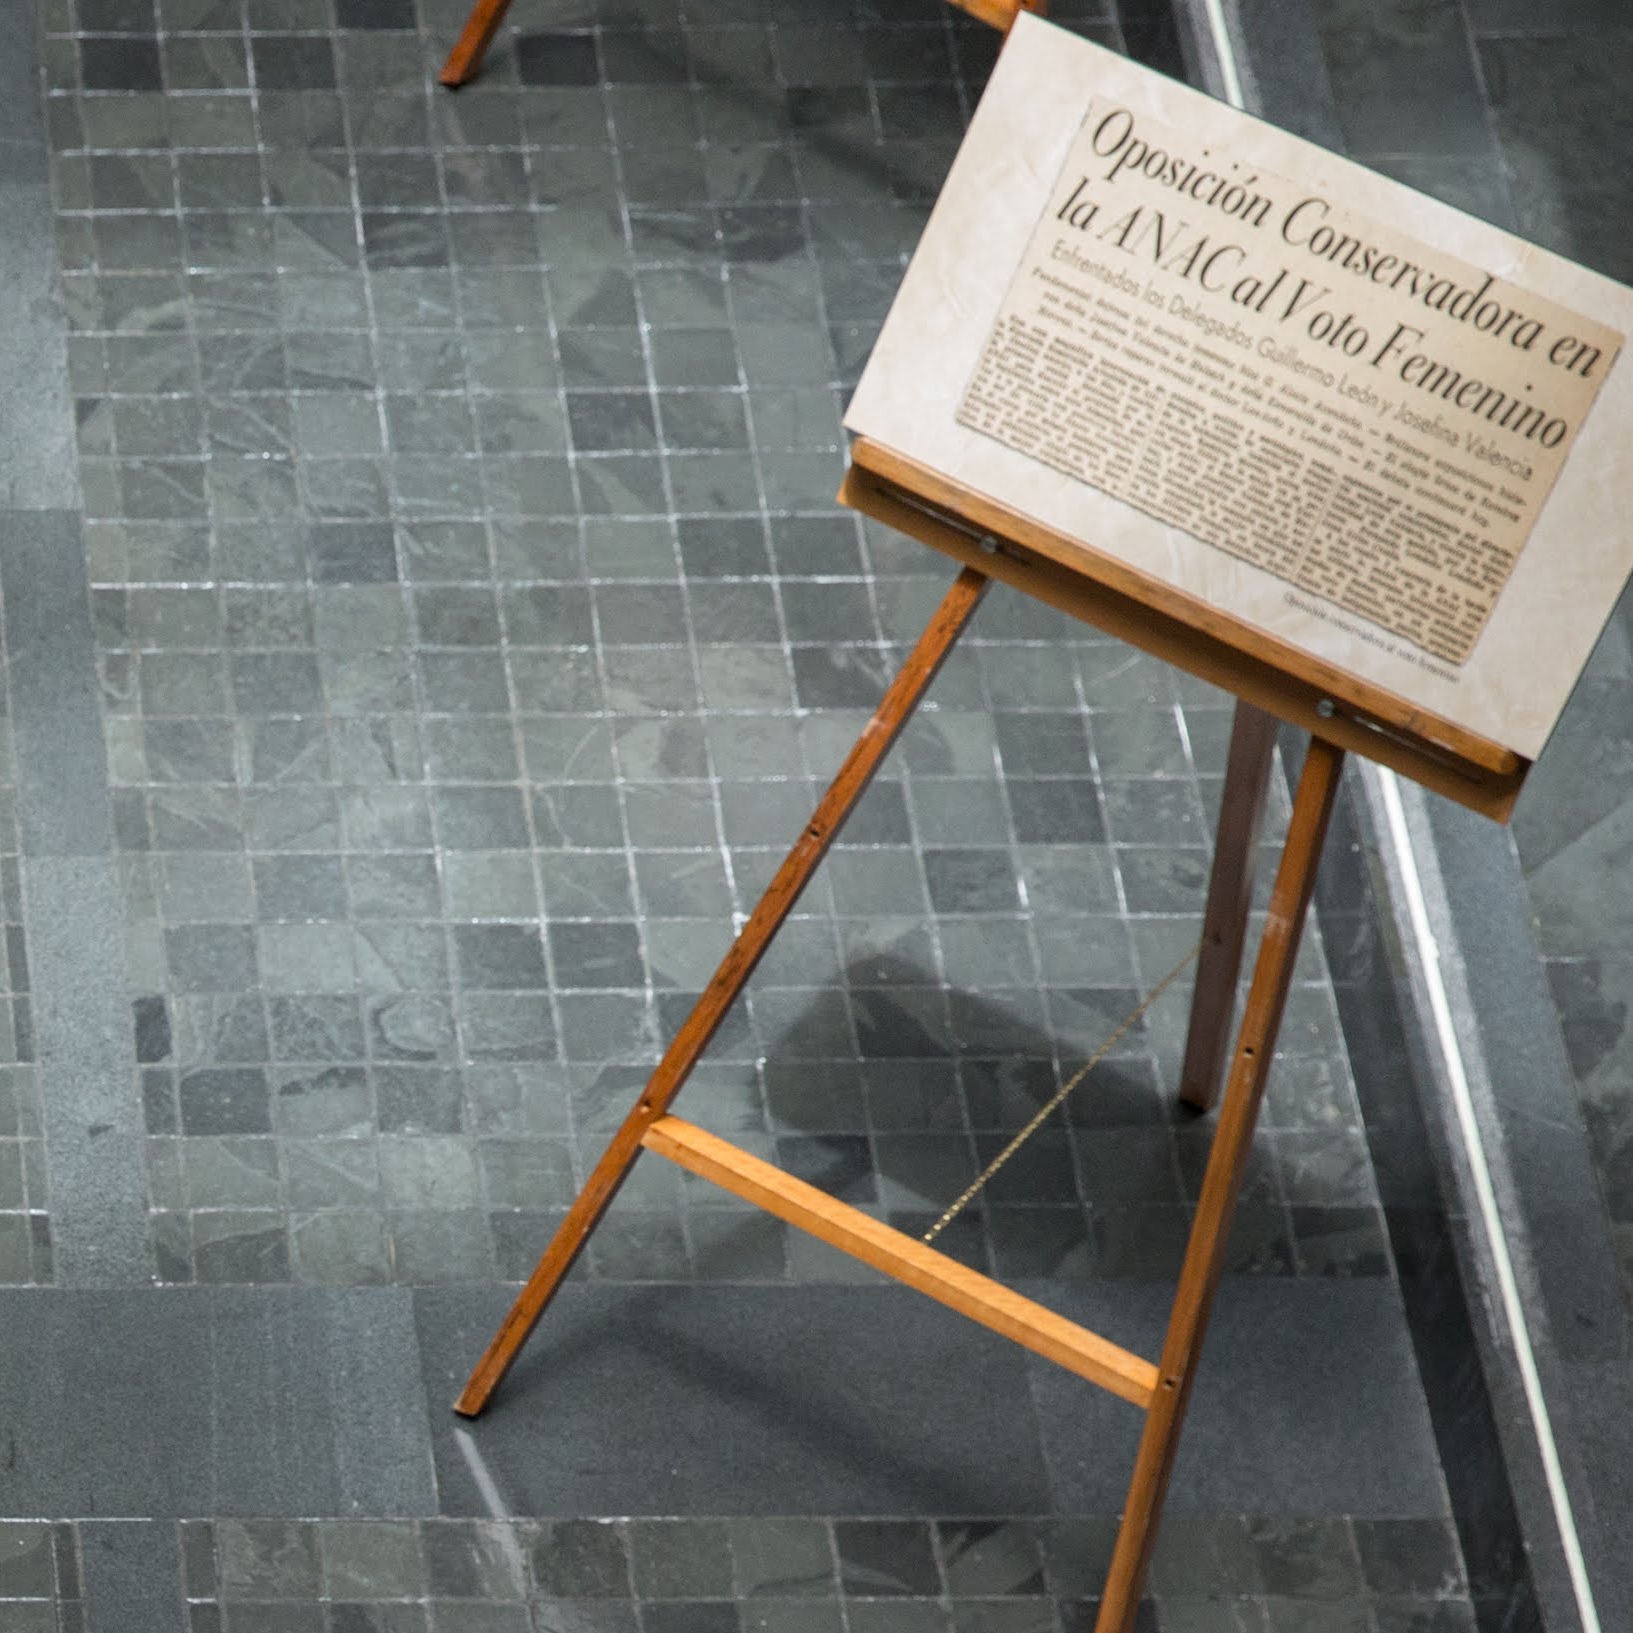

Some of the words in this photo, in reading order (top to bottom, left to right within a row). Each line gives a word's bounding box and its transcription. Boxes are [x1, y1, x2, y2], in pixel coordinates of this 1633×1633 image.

[1050, 239, 1139, 297] Enfrentados
[1142, 280, 1165, 309] los
[1168, 294, 1254, 349] Delegados
[1257, 335, 1335, 388] Guillermo
[1336, 372, 1380, 407] León
[1393, 400, 1461, 447] Josefina
[1464, 432, 1532, 481] Valencia
[1057, 177, 1100, 231] la
[1096, 206, 1247, 292] ANAC
[1231, 269, 1288, 312] al
[1280, 279, 1369, 357] Voto
[1370, 322, 1567, 449] Femenino
[1092, 108, 1273, 227] Oposición
[1282, 197, 1544, 351] Conservadora
[1548, 335, 1603, 378] en
